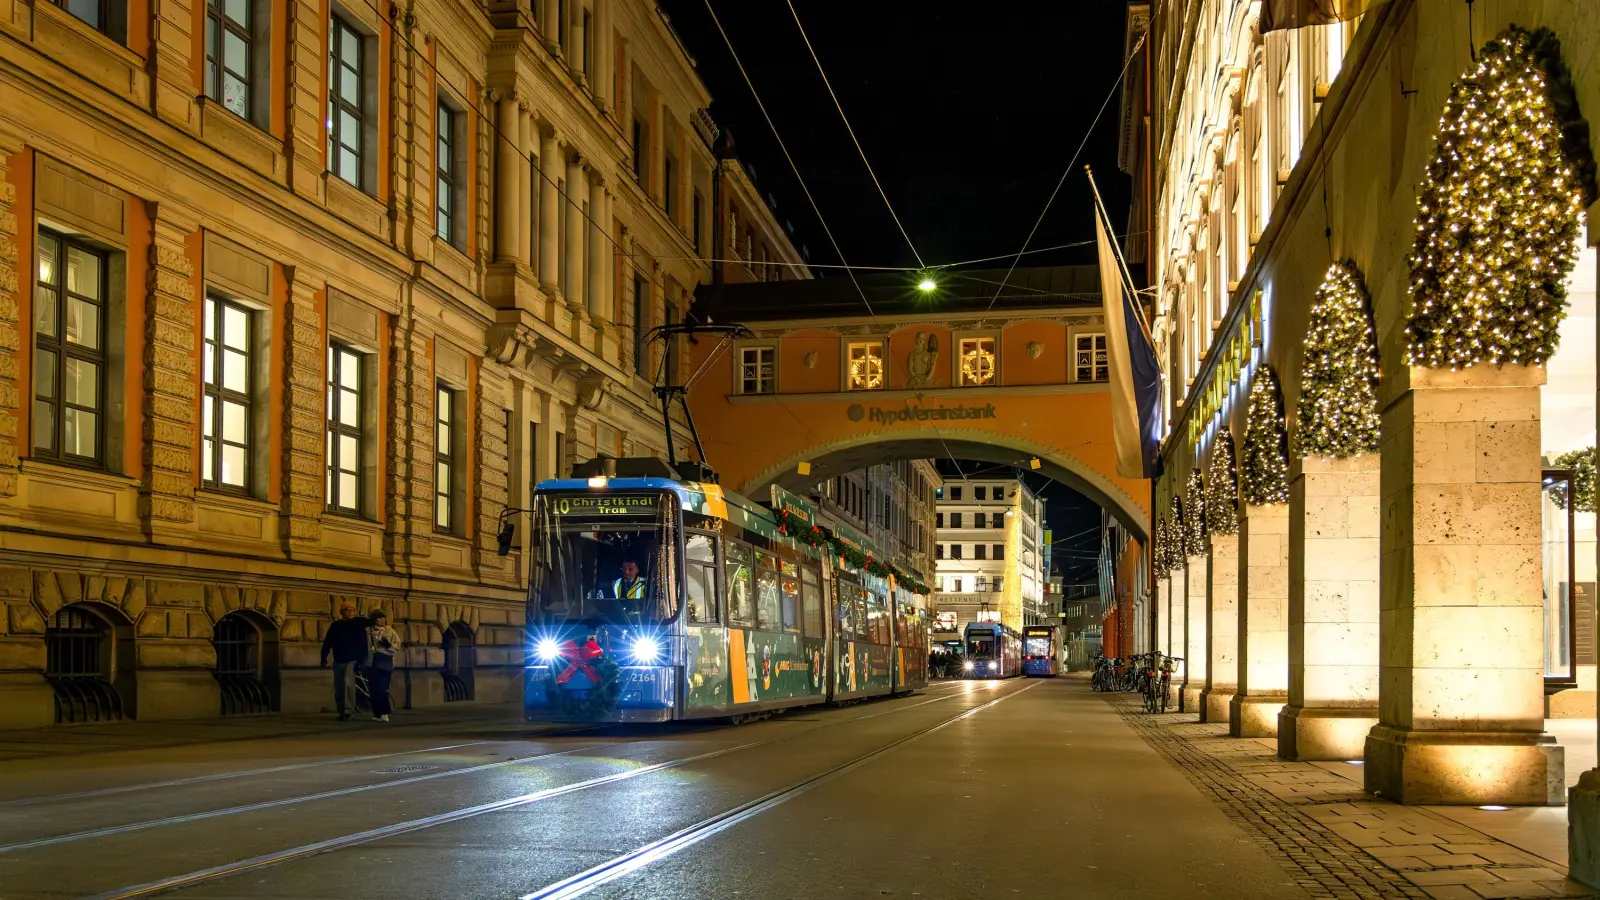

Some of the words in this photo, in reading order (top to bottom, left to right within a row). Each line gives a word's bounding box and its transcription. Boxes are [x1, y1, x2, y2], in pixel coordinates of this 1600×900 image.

[869, 403, 996, 426] HypoVereinsbank
[552, 499, 570, 515] 10
[573, 497, 653, 506] Christkindl
[599, 506, 627, 514] Tram
[632, 673, 656, 682] 2164
